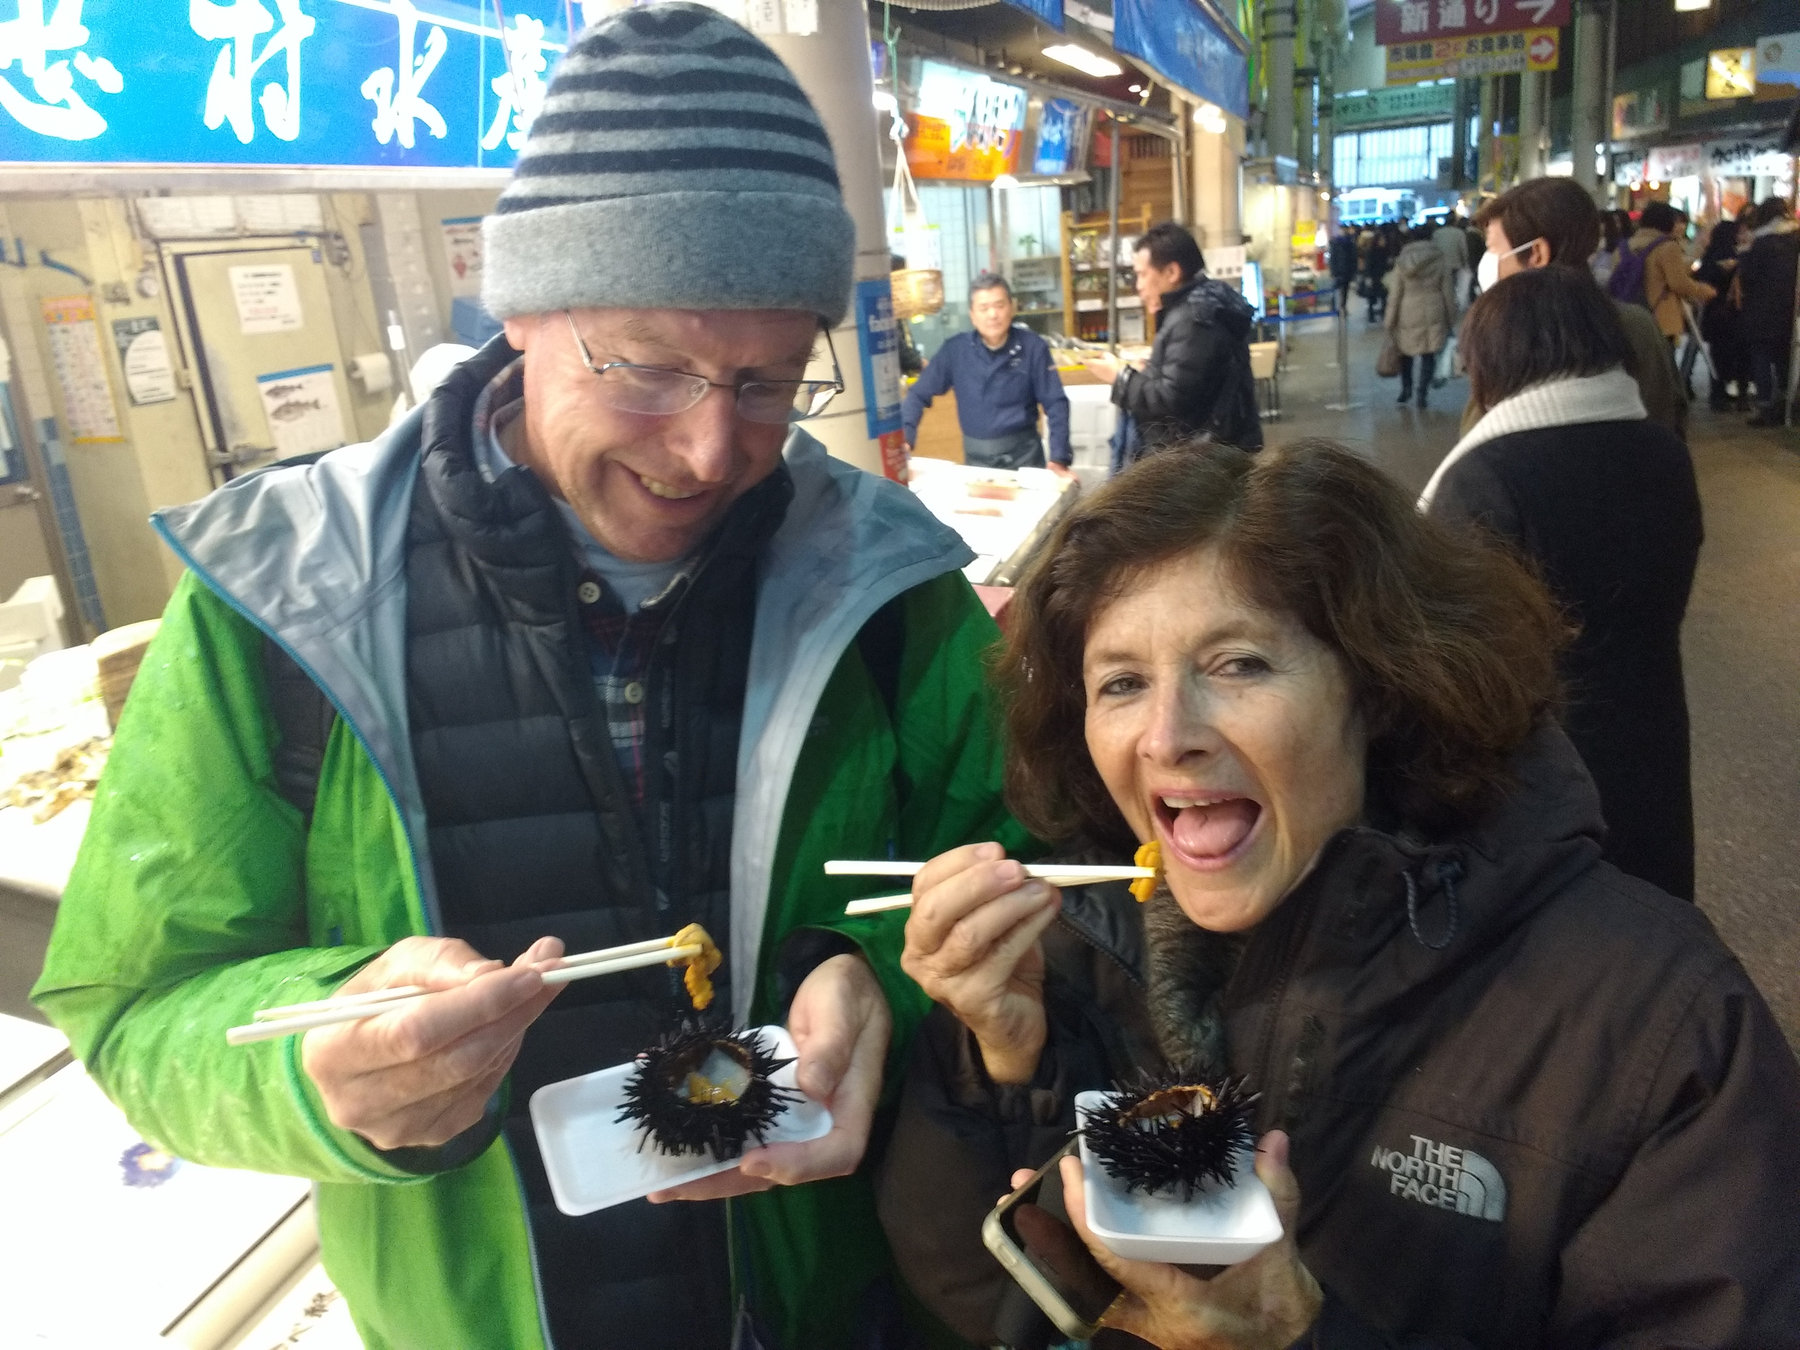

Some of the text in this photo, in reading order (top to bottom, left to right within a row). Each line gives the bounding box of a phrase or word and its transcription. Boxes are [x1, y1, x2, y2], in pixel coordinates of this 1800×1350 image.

[1370, 1145, 1461, 1191] NORTH
[1409, 1134, 1464, 1169] THE
[1390, 1173, 1459, 1211] FACE
